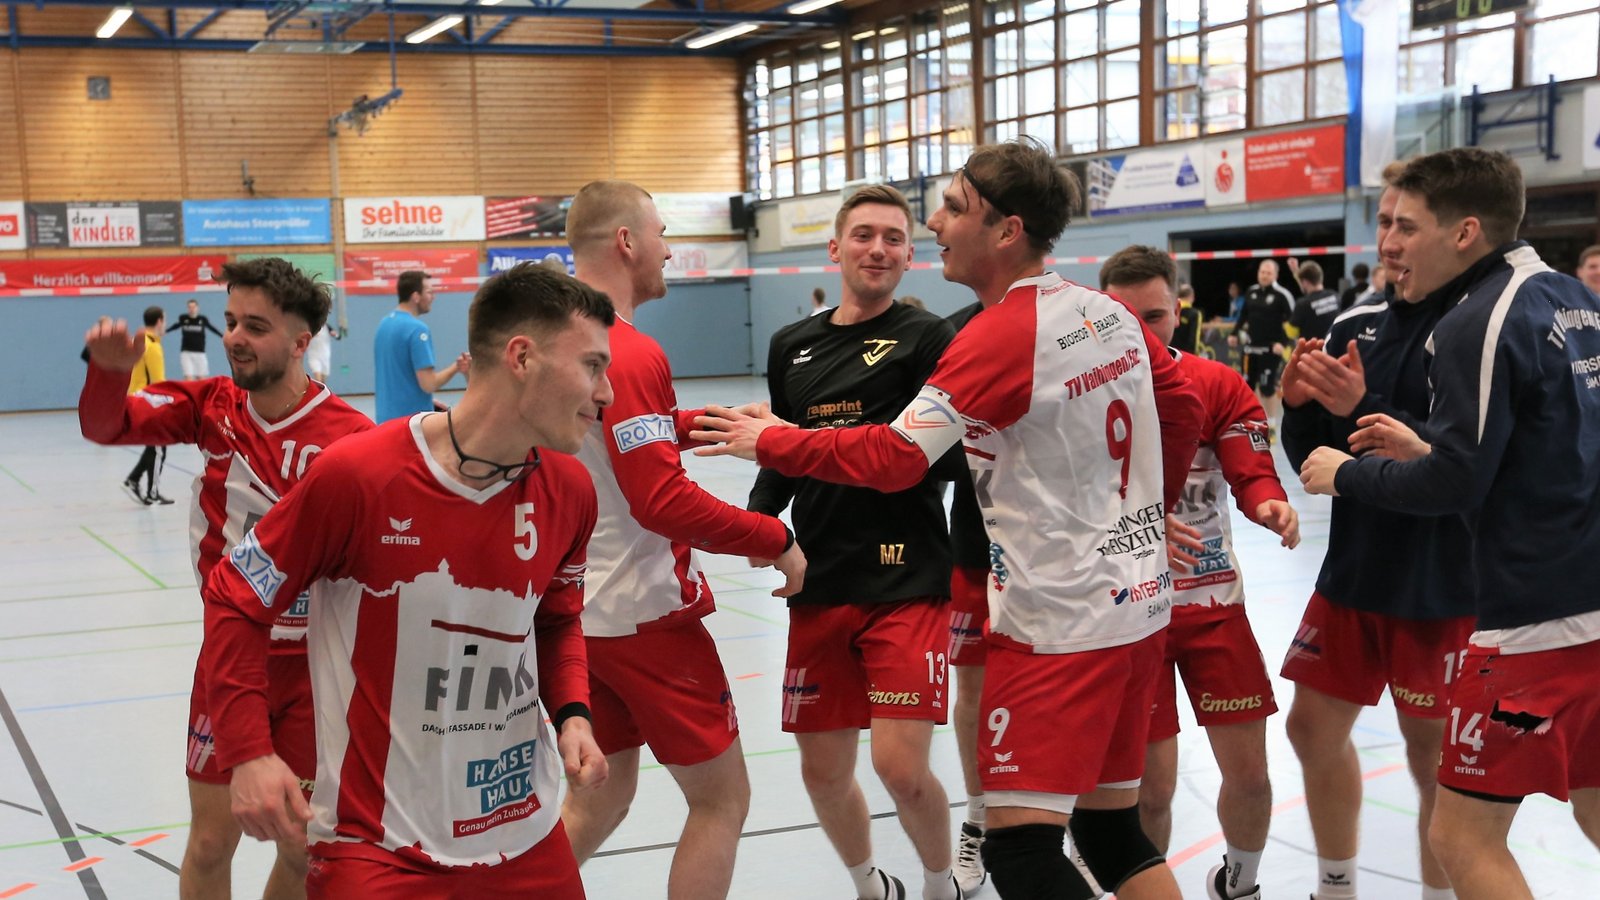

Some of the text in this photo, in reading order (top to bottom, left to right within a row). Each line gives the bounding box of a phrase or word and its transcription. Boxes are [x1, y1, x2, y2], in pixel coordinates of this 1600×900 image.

[71, 211, 95, 225] der
[361, 199, 443, 225] sehne
[203, 218, 250, 230] Autohaus
[33, 271, 173, 287] Herzlich willkommen
[1057, 327, 1089, 350] BIOHOF
[1093, 312, 1121, 333] BRAUN
[1064, 376, 1082, 400] TV
[1105, 398, 1133, 500] 9
[381, 533, 421, 546] erima
[513, 502, 538, 561] 5
[880, 543, 905, 565] MZ
[925, 651, 946, 685] 13
[1200, 692, 1262, 713] Emons
[448, 722, 487, 733] FASSADE
[987, 707, 1011, 748] 9
[1450, 707, 1485, 752] 14
[474, 745, 533, 782] HANSE
[989, 764, 1020, 774] erima
[1454, 766, 1486, 776] erima
[459, 820, 486, 833] Genau
